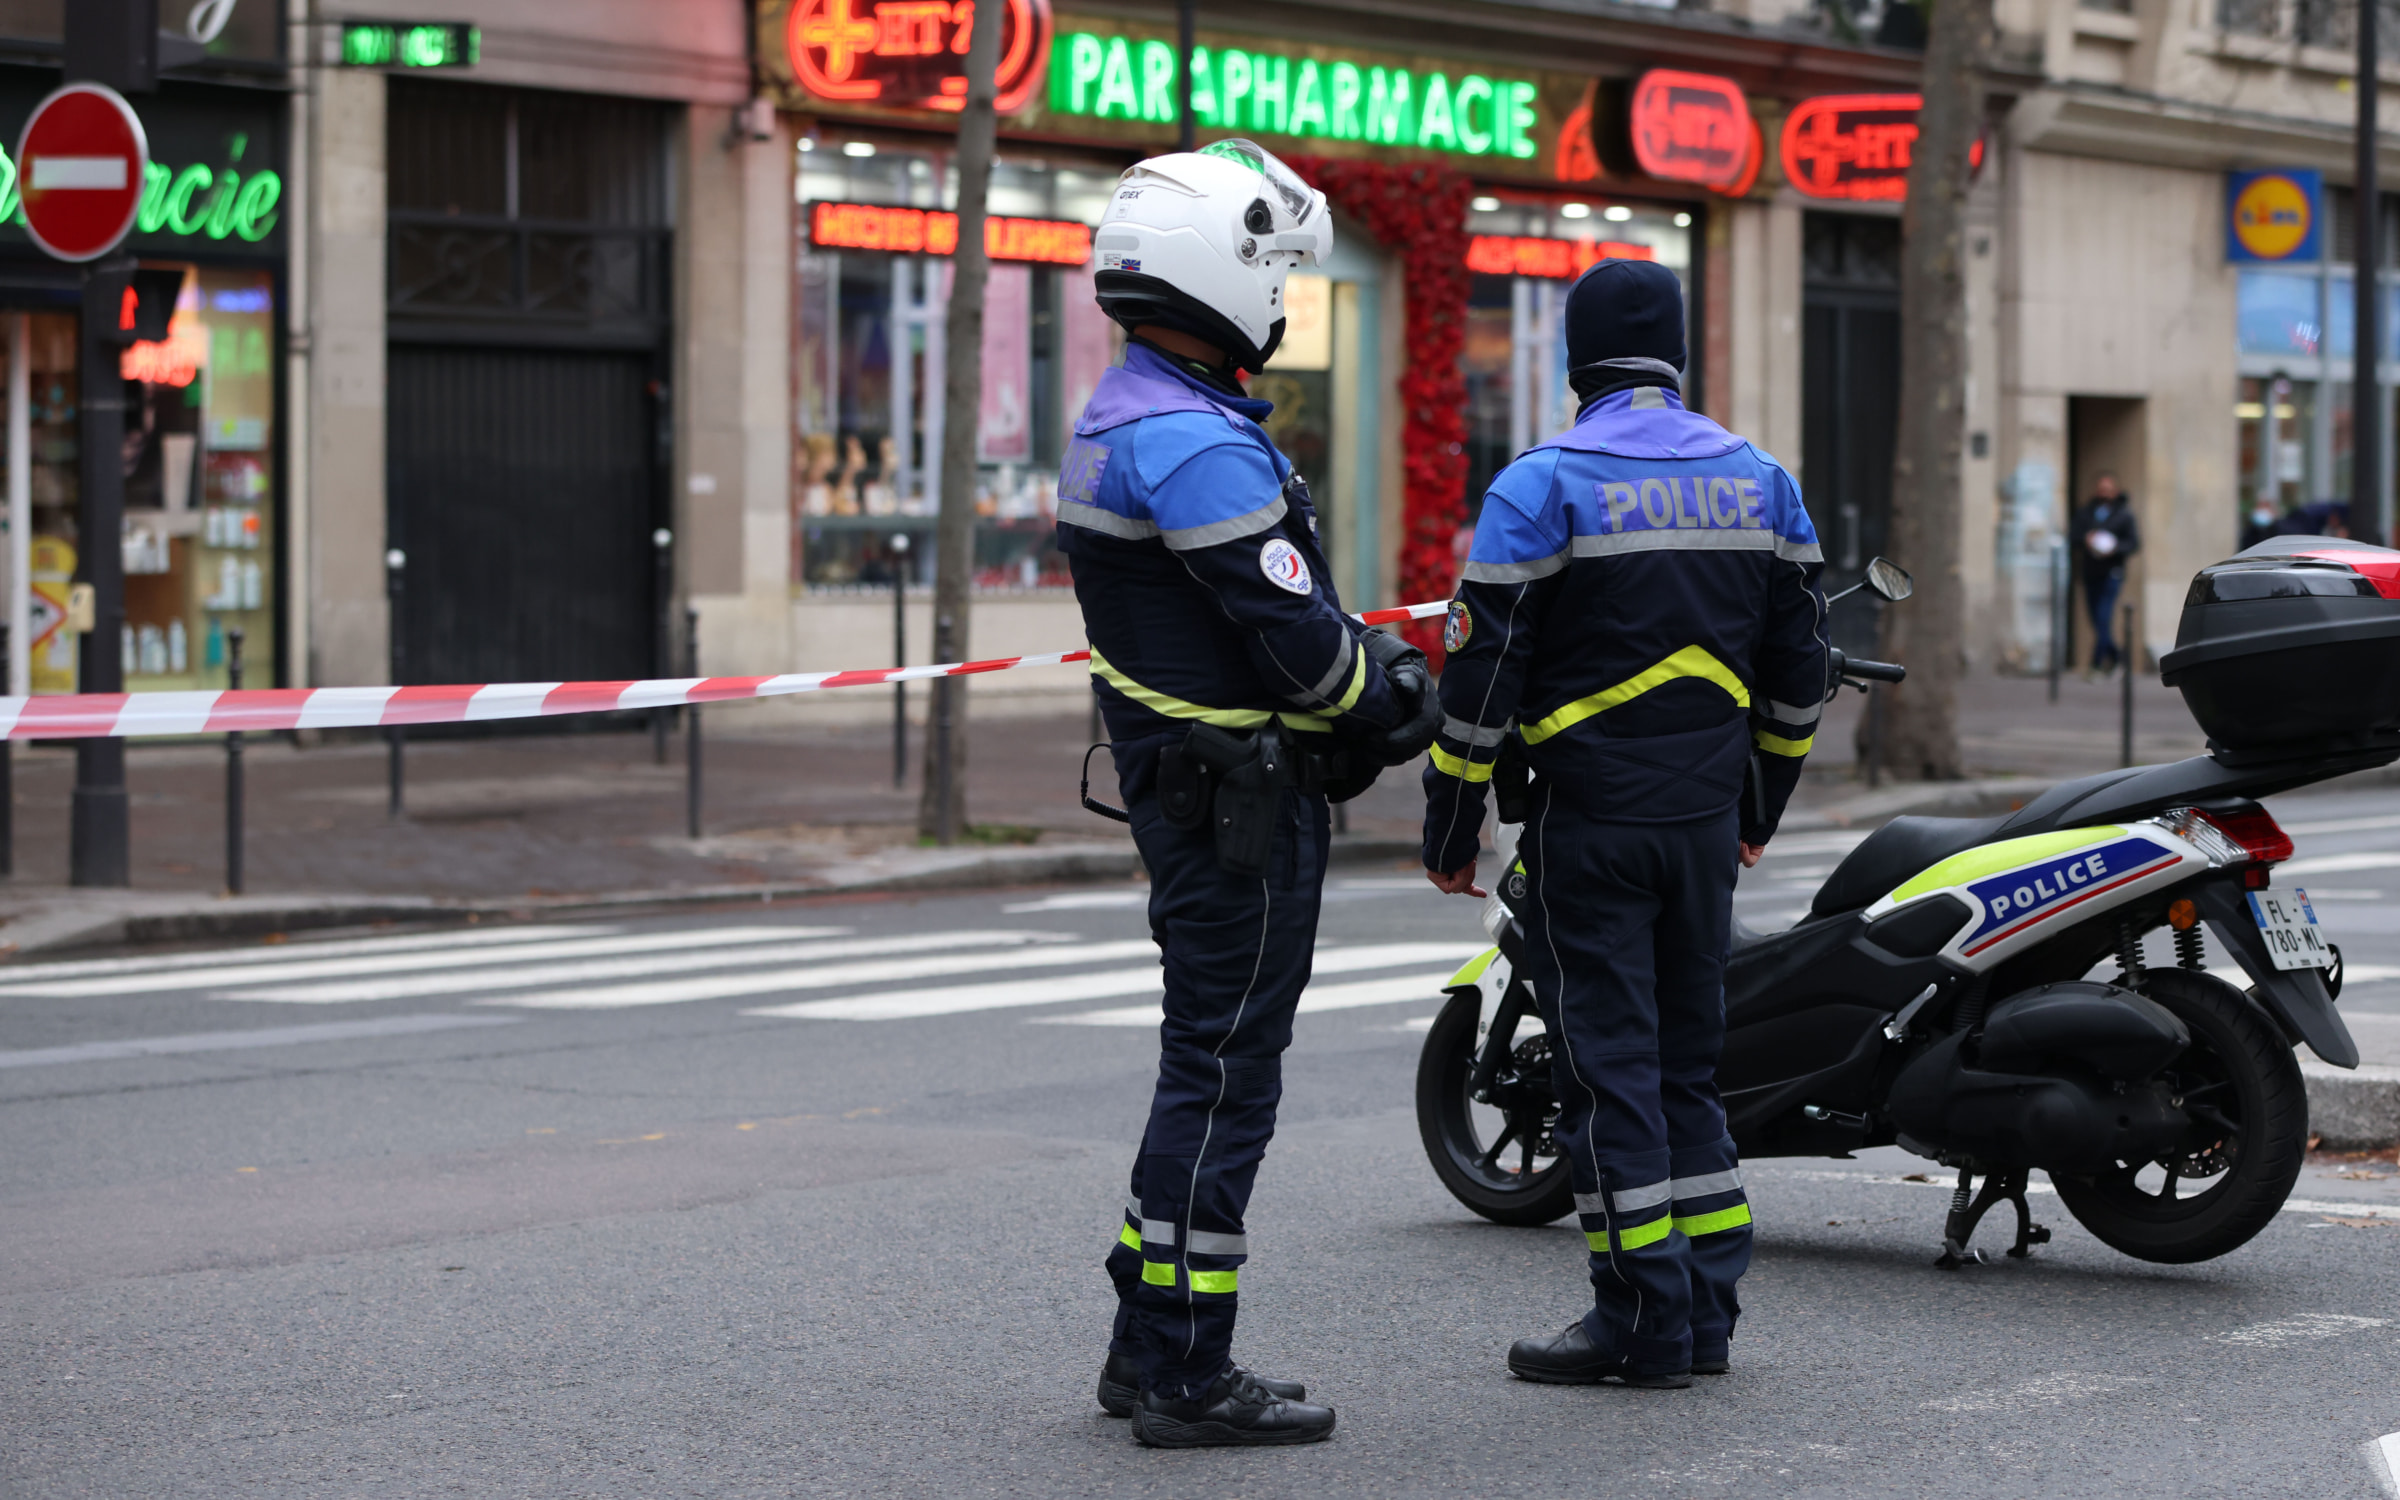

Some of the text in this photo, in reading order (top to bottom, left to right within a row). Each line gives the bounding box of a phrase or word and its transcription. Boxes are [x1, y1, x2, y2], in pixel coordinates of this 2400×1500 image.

[1071, 33, 1537, 158] PARAPHARMACIE
[1603, 477, 1760, 532] POLICE
[1990, 852, 2108, 920] POLICE
[2265, 928, 2326, 954] 780-ML
